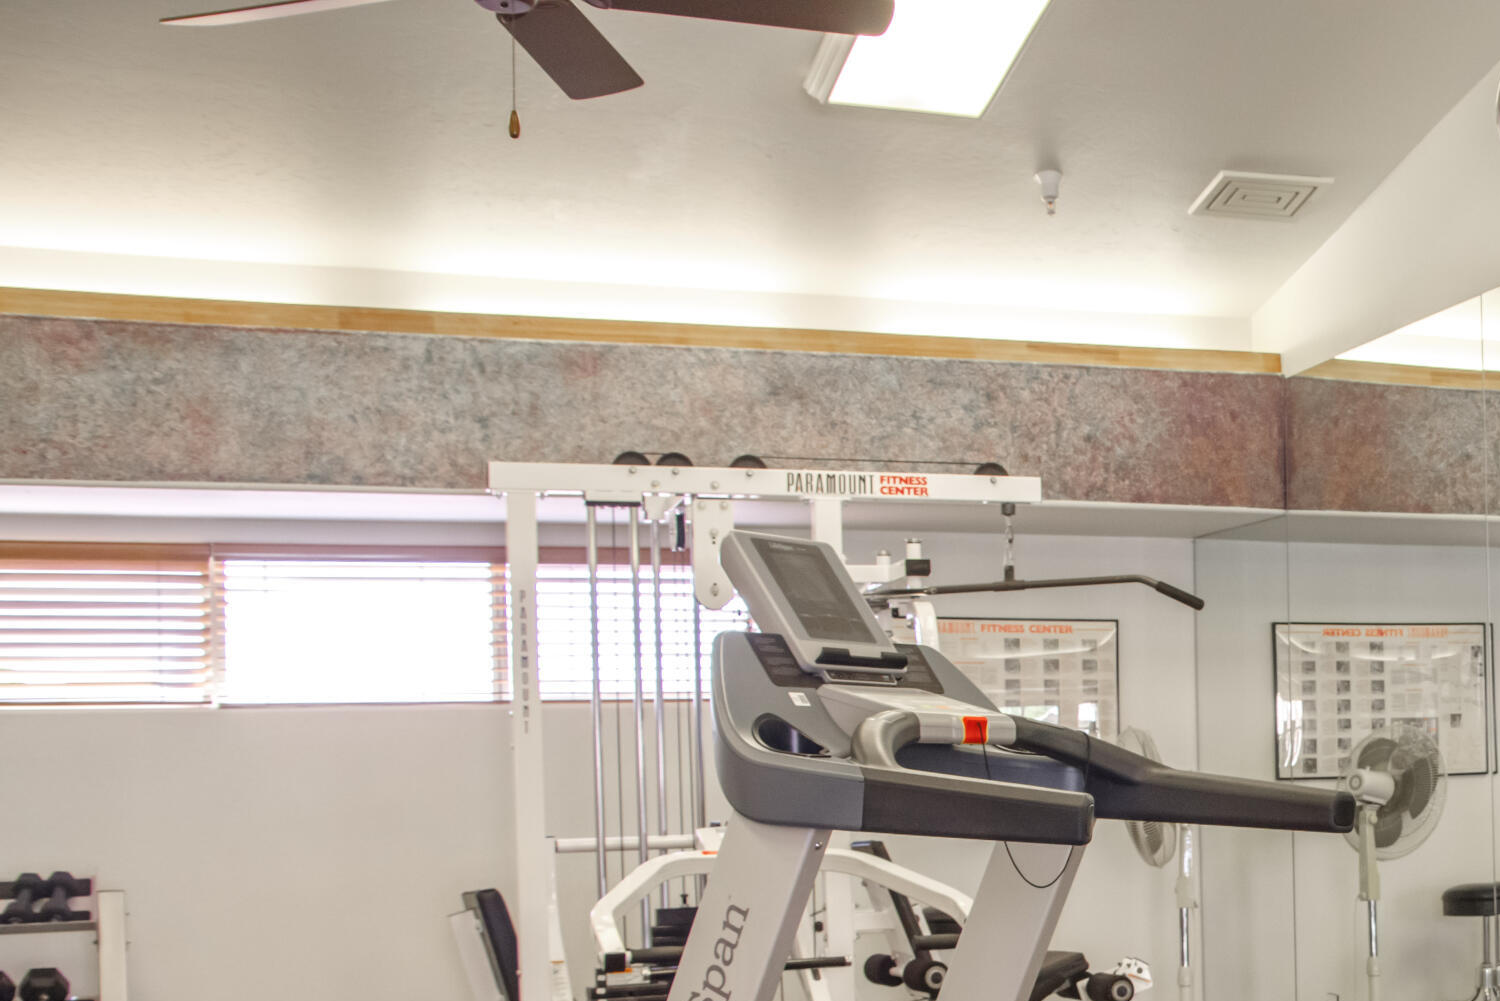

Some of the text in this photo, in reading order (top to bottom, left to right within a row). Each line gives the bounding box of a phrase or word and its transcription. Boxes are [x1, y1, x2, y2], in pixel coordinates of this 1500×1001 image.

[786, 472, 875, 495] PARAMOUNT
[879, 475, 928, 486] FITNESS
[879, 485, 929, 497] CENTER
[980, 623, 1025, 634] FITNESS
[1028, 624, 1073, 634] CENTER
